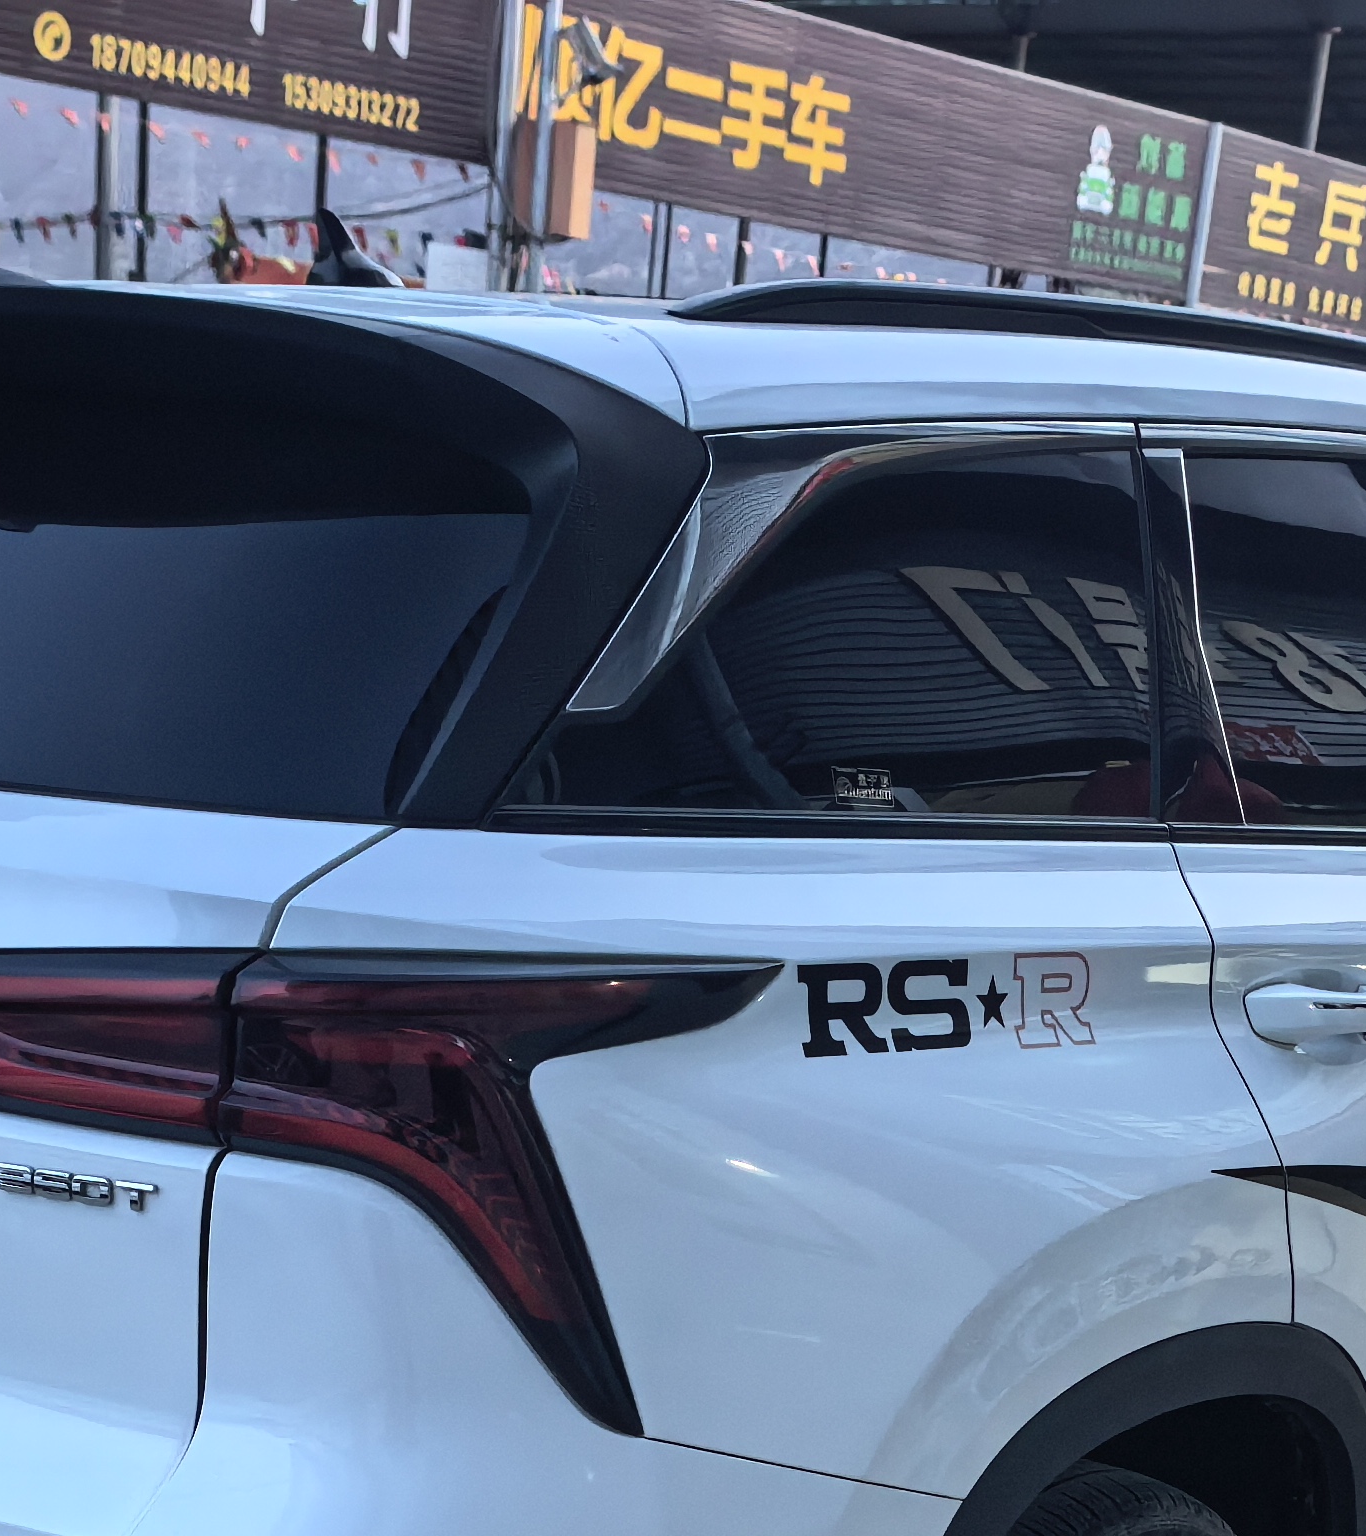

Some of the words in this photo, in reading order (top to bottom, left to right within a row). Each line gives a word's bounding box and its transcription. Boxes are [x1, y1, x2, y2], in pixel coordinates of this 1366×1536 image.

[89, 33, 251, 99] 18709440944
[281, 71, 421, 133] 15309313272
[797, 958, 972, 1058] RS
[1012, 951, 1097, 1050] R
